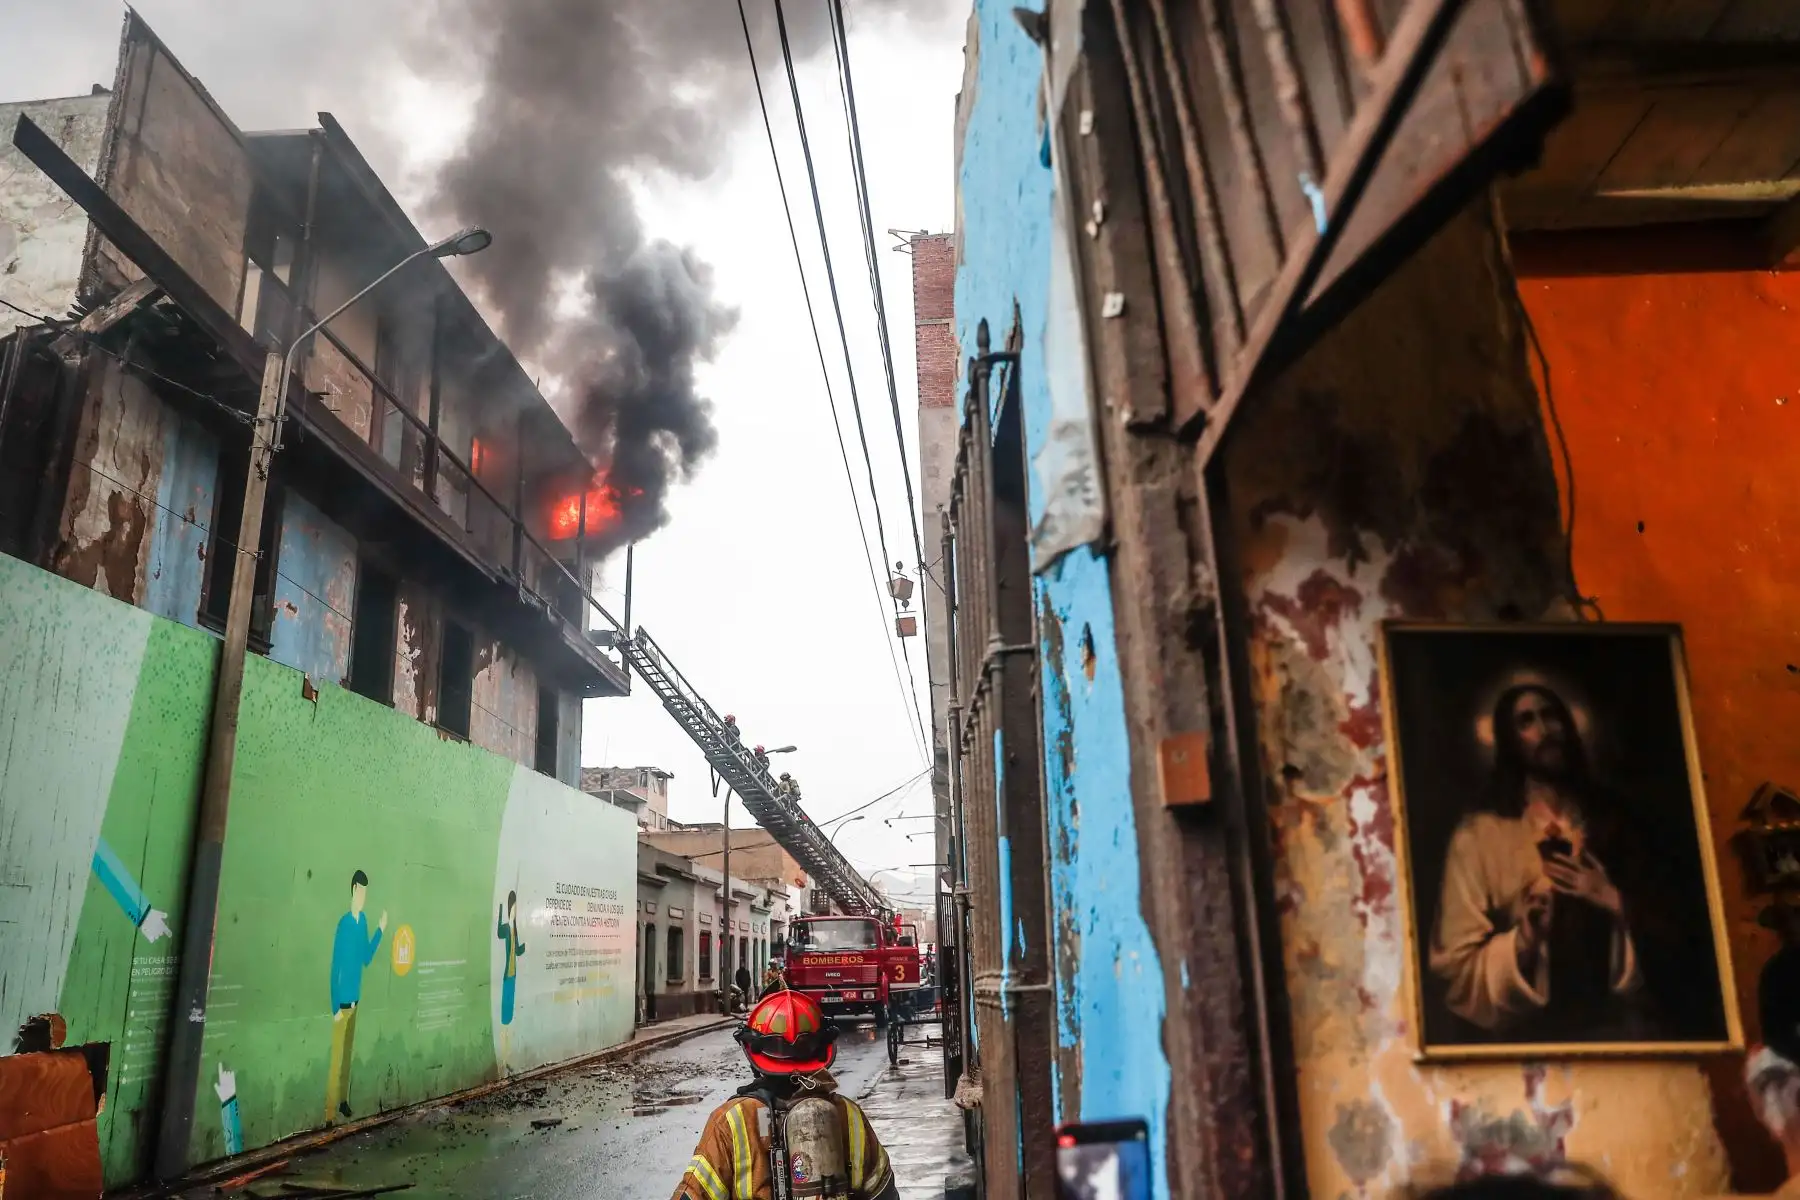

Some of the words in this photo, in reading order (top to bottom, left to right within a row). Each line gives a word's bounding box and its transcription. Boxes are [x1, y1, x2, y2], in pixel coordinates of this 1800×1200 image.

[562, 884, 580, 896] CUIDADO
[803, 955, 864, 965] BOMBEROS
[895, 964, 905, 981] 3
